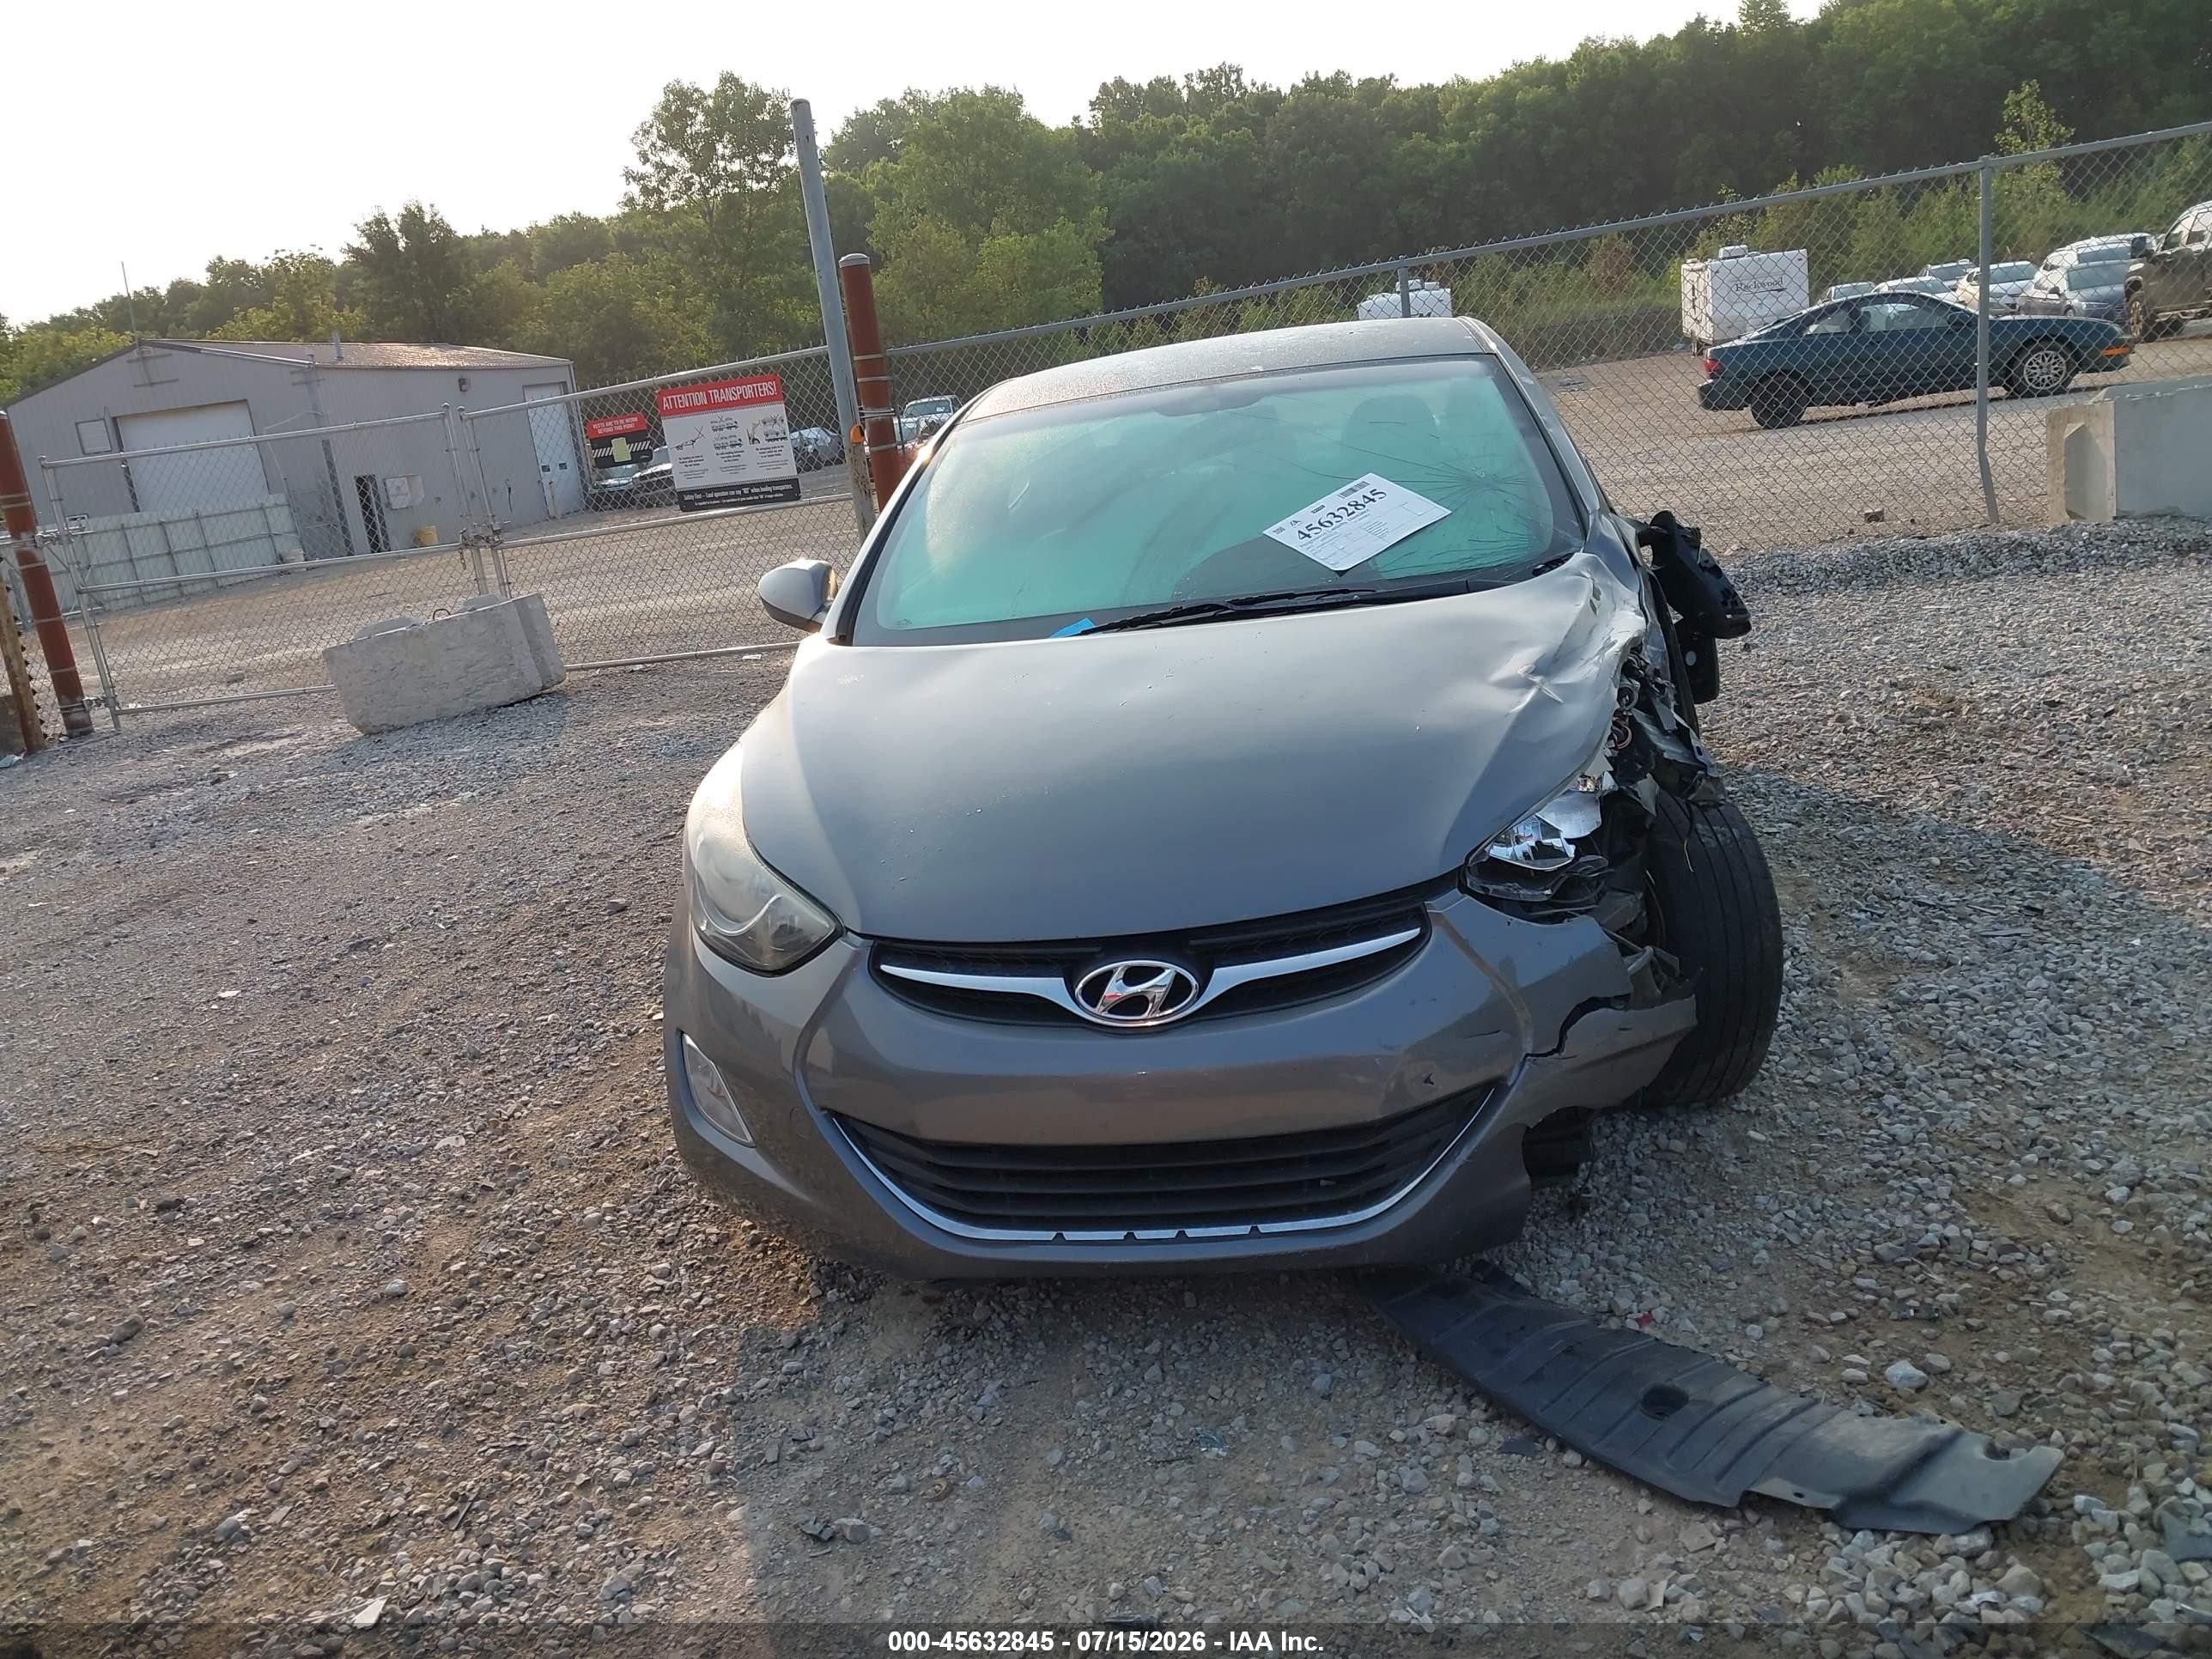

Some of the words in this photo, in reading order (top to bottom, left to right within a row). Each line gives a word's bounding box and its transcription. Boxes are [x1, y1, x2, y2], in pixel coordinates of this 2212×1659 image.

[663, 392, 708, 410] ATTENTION
[708, 381, 777, 404] TRANSPORTERS!
[1297, 489, 1387, 542] 45632845
